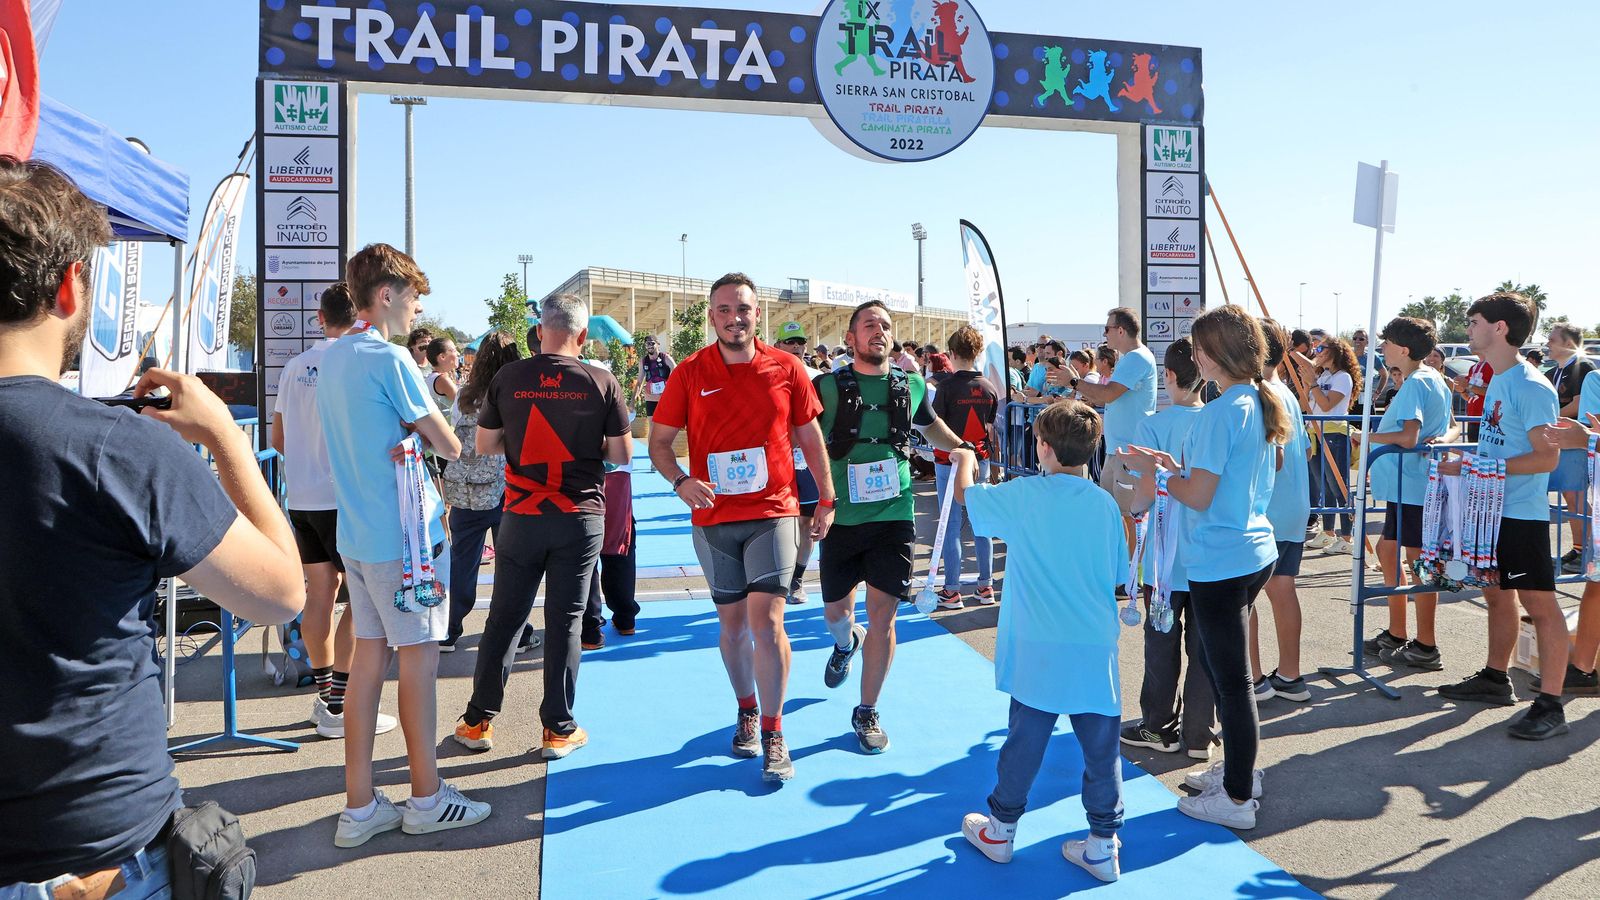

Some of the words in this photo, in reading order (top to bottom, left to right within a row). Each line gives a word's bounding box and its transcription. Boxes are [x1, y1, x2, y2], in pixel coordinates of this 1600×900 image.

[301, 5, 515, 71] TRAIL
[540, 19, 778, 84] PIRATA
[838, 22, 959, 62] TRAIL
[890, 61, 963, 83] PIRATA
[835, 84, 878, 97] SIERRA
[882, 86, 906, 99] SAN
[910, 88, 975, 102] CRISTOBAL
[869, 102, 901, 114] TRAIL
[904, 104, 944, 115] PIRATA
[860, 122, 913, 134] CAMINATA
[916, 125, 952, 135] PIRATA
[890, 138, 924, 151] 2022
[269, 165, 333, 175] LIBERTIUM
[1155, 204, 1191, 215] INAUTO
[276, 231, 328, 243] INAUTO
[1150, 243, 1196, 251] LIBERTIUM
[826, 286, 854, 303] Estadio
[884, 294, 909, 309] Garrido
[121, 287, 136, 354] GERMAN
[216, 294, 226, 350] GERMAN
[726, 463, 757, 480] 892
[864, 473, 891, 489] 981
